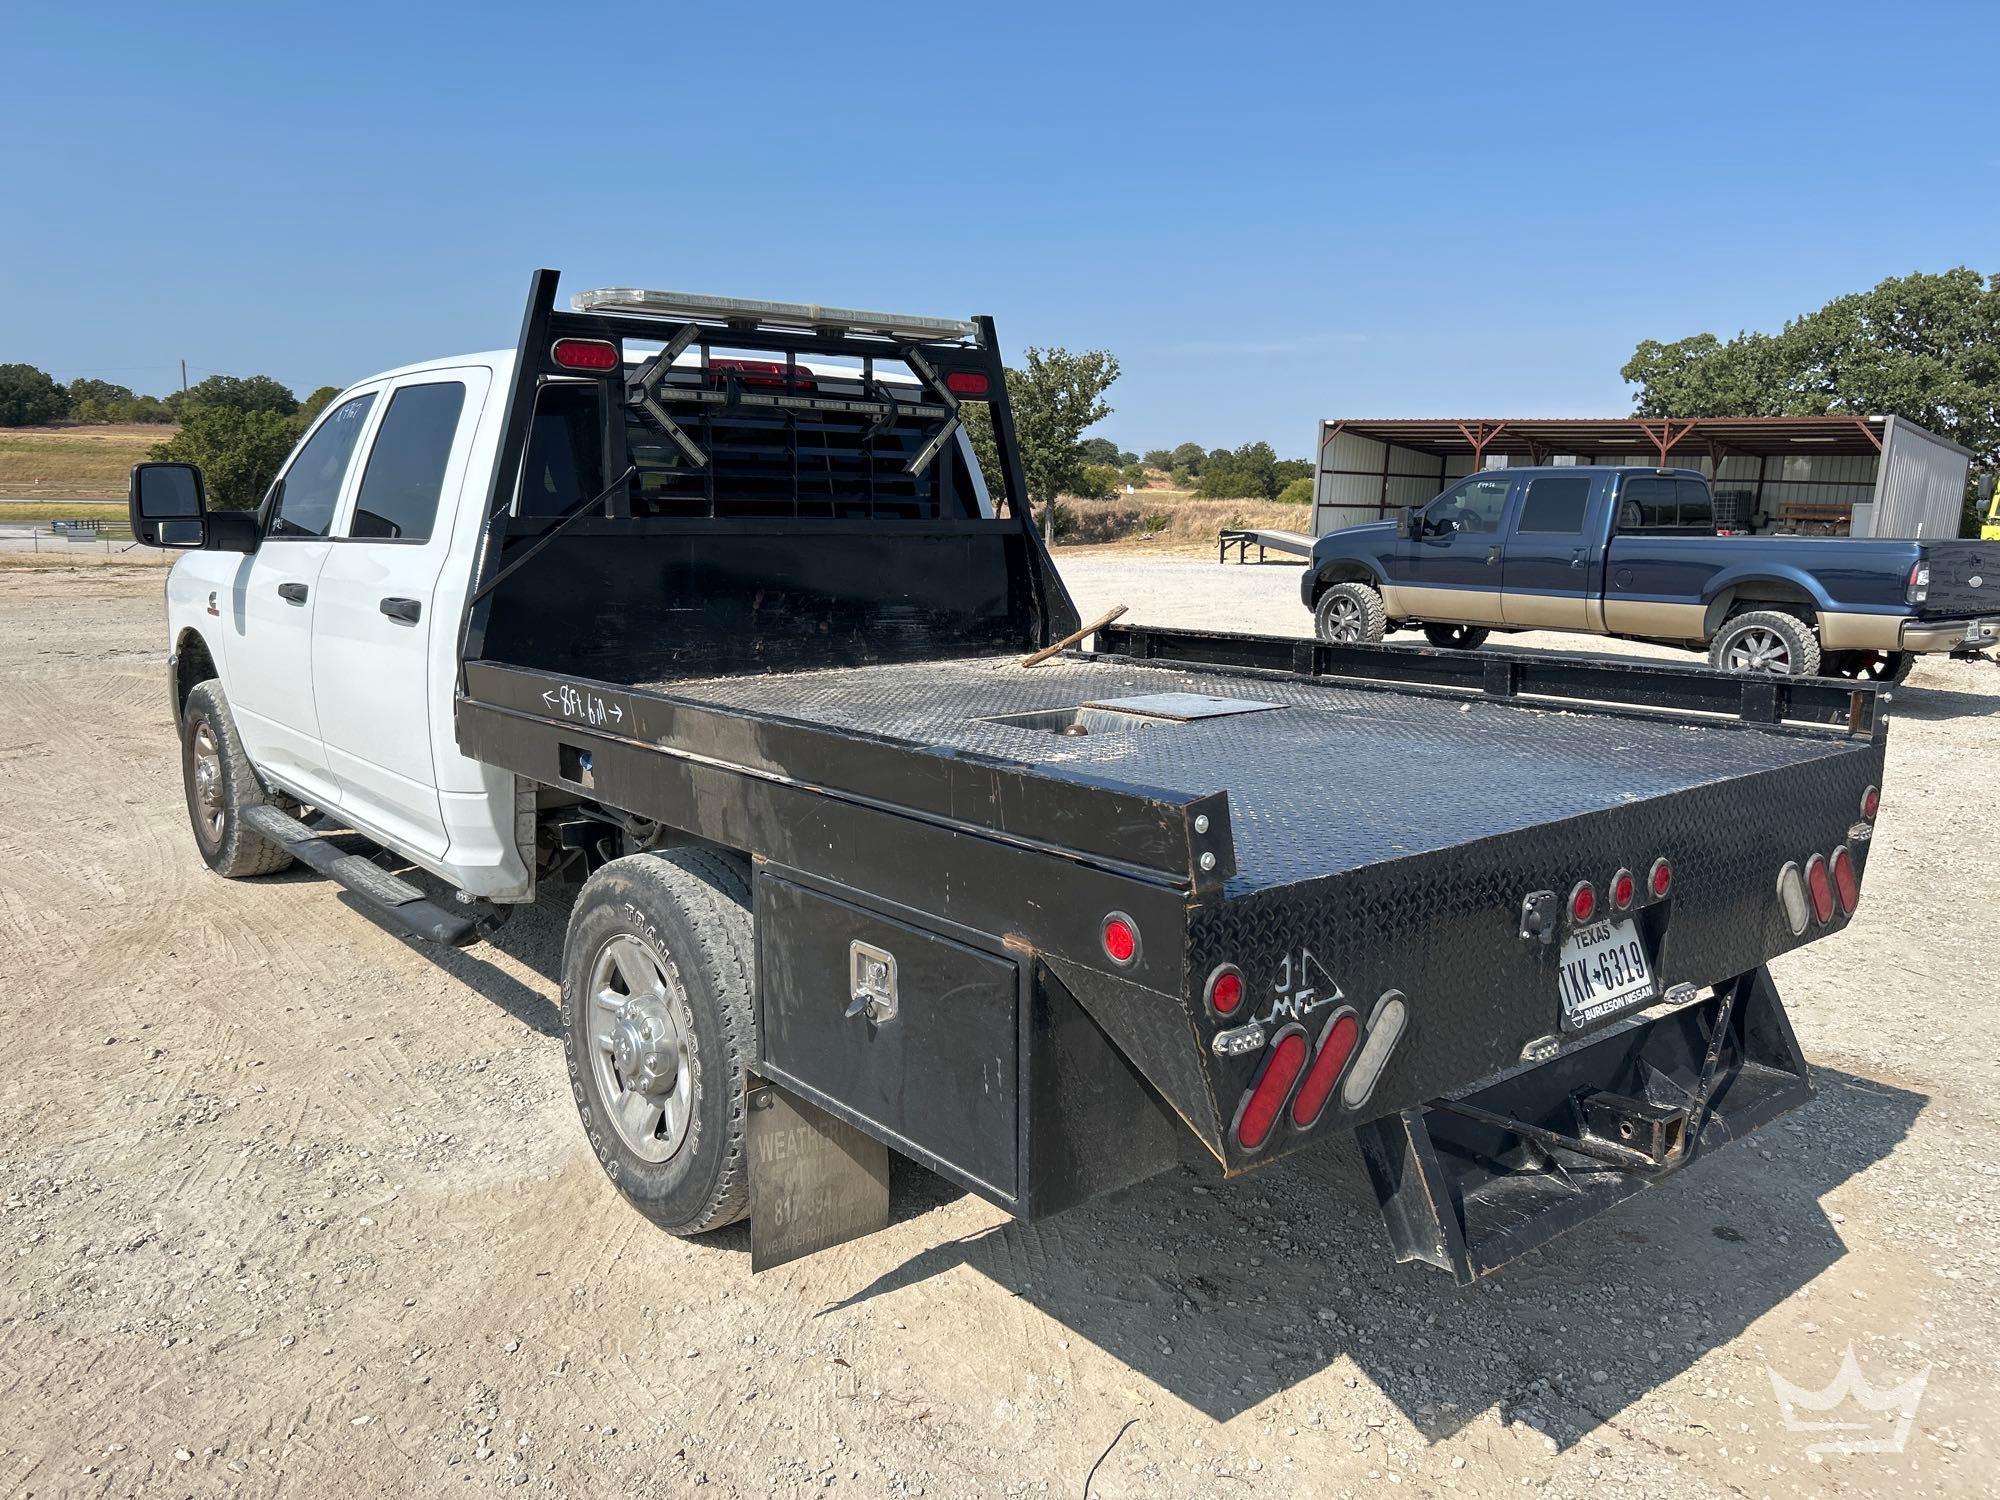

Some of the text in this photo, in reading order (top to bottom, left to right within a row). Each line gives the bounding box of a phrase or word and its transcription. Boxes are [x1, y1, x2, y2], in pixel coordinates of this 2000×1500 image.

[1573, 924, 1611, 949] TEXAS
[1583, 999, 1627, 1021] BURLESON
[1625, 985, 1653, 1006] NISSAN
